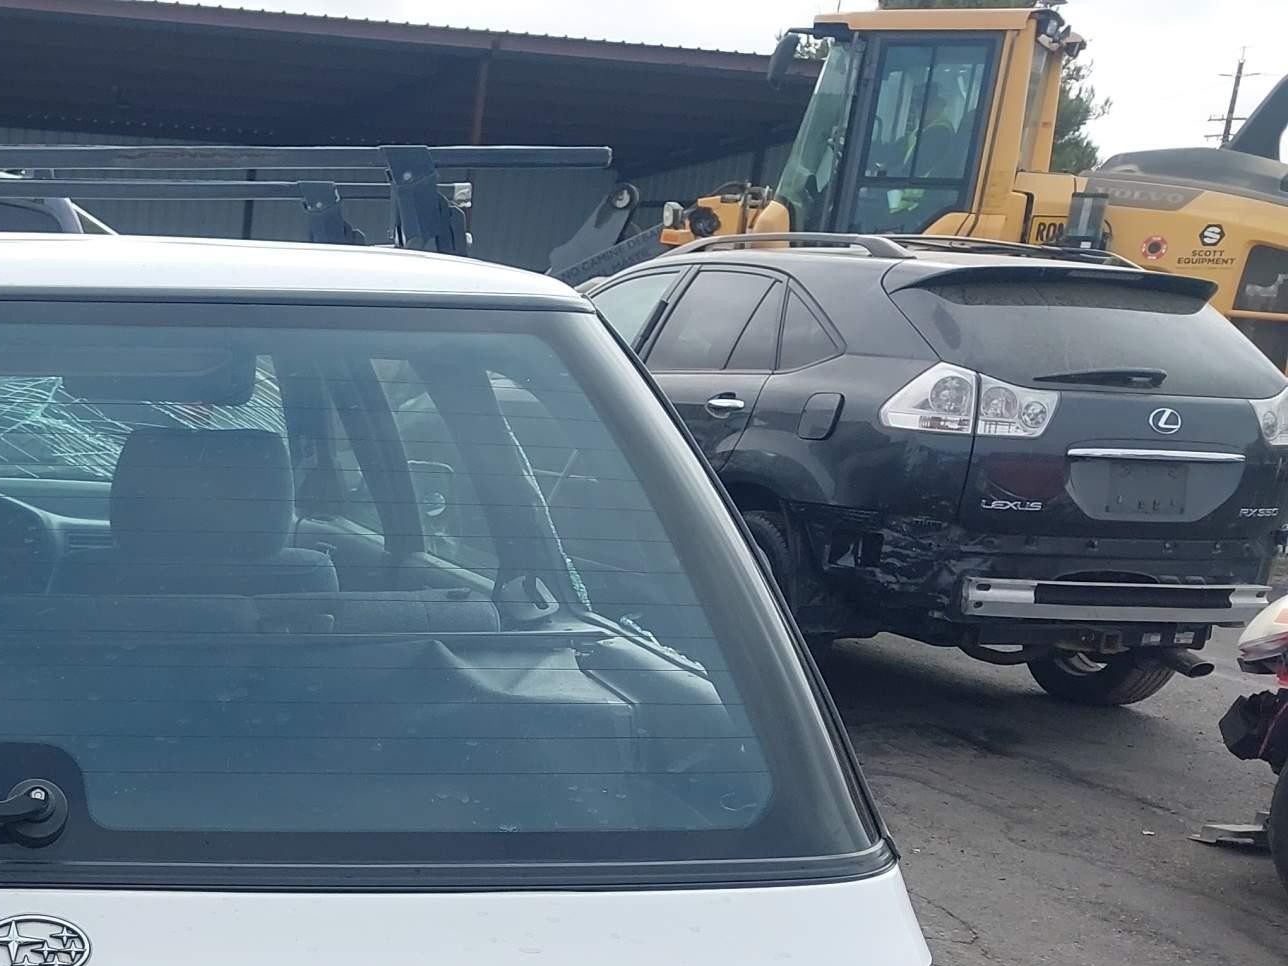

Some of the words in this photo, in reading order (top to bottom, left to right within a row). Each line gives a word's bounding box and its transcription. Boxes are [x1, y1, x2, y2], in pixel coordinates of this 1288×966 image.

[1192, 249, 1224, 257] SCOTT
[1177, 257, 1236, 265] EQUIPMENT
[981, 499, 1042, 511] LEXUS
